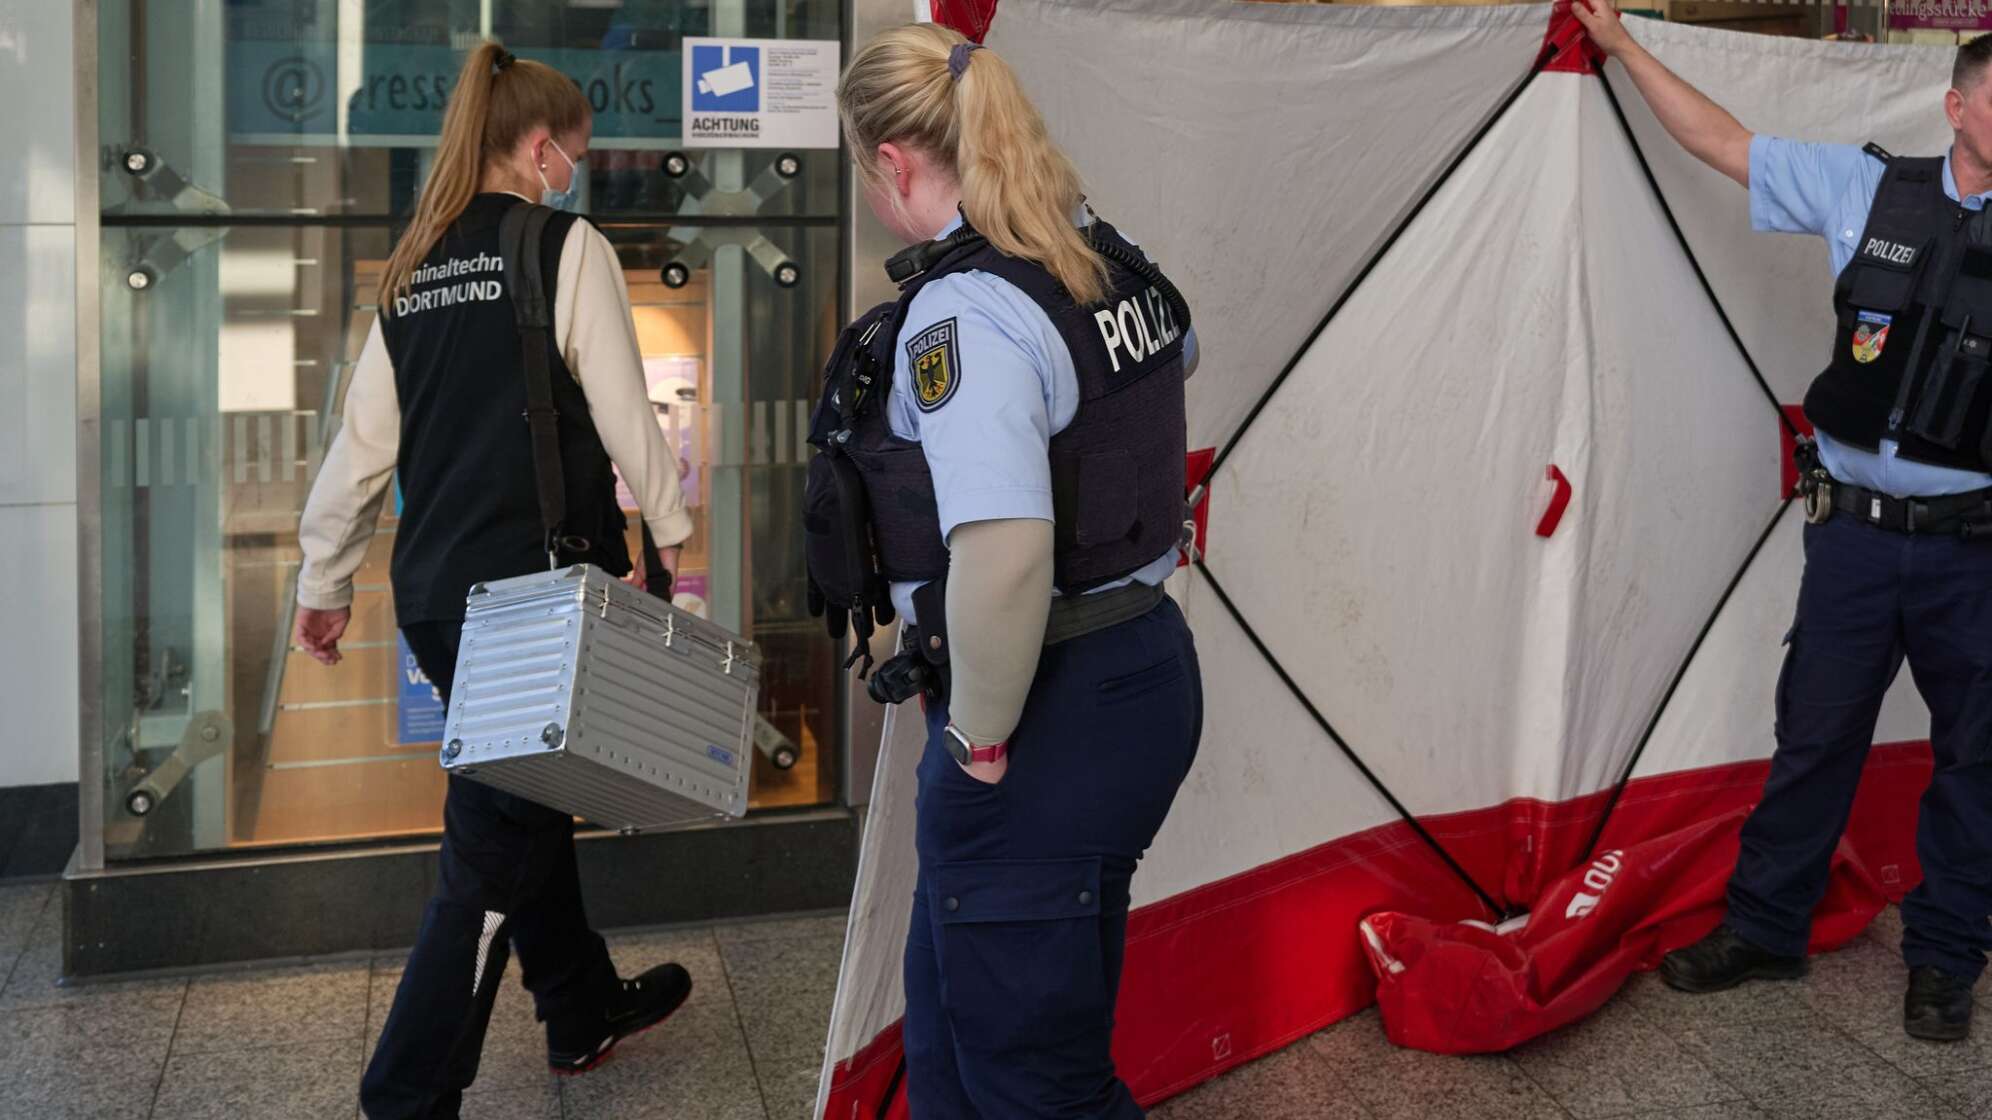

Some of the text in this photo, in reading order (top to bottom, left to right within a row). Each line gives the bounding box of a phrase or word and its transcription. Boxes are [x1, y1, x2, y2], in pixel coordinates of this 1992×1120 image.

[692, 117, 760, 131] ACHTUNG
[1864, 237, 1916, 263] POLIZEI
[396, 280, 502, 317] DORTMUND
[913, 326, 949, 359] POLIZEI
